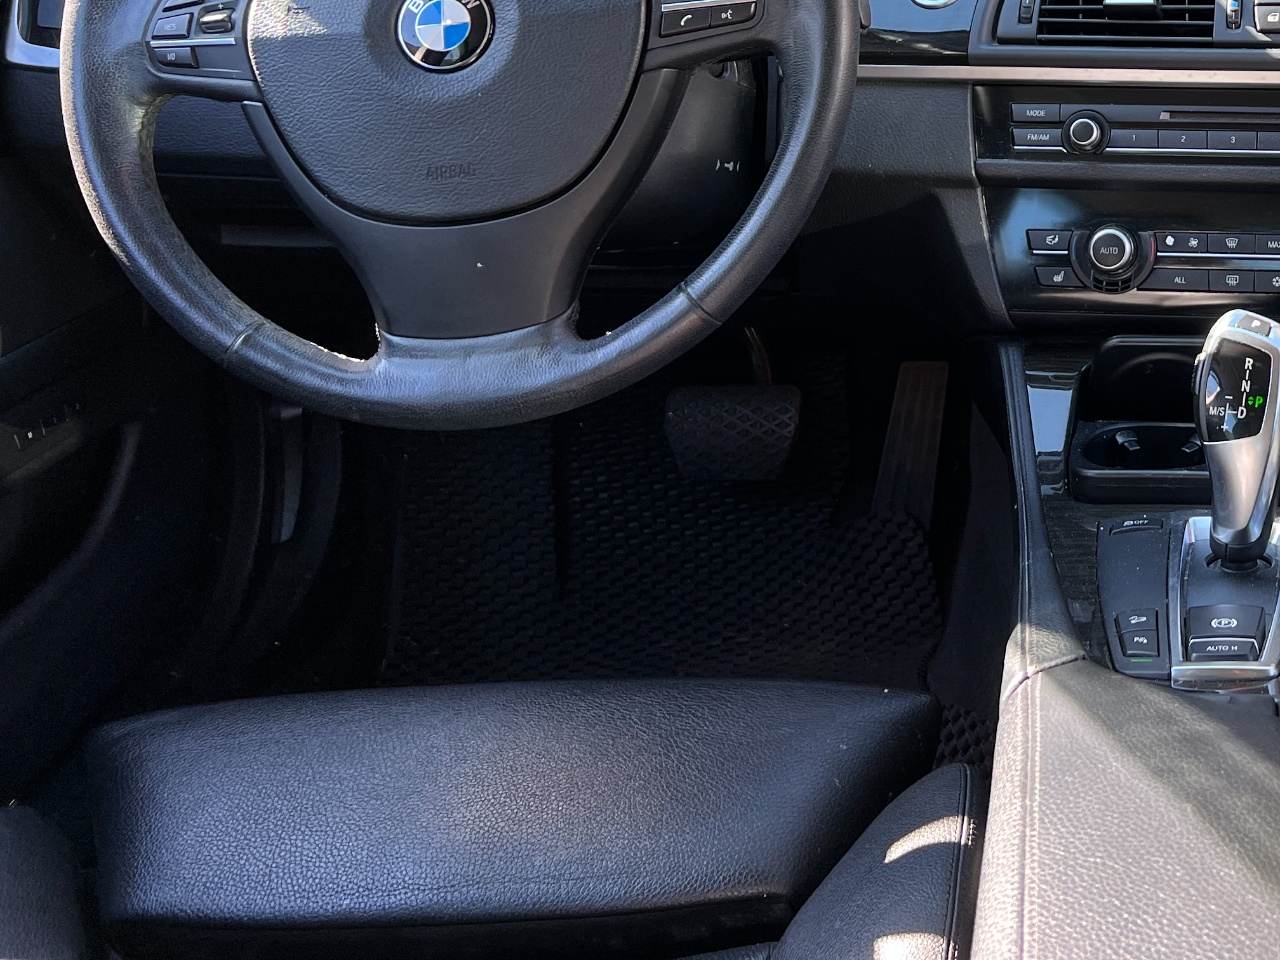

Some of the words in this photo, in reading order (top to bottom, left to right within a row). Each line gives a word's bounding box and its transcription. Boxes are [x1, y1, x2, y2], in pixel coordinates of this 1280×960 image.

[163, 22, 177, 31] RES
[1026, 109, 1046, 117] MODE
[1027, 133, 1050, 141] FM/AM
[1132, 134, 1136, 142] 1
[1180, 135, 1186, 143] 2
[1230, 136, 1236, 144] 3
[424, 163, 478, 181] AIRBAG
[1100, 246, 1119, 255] AUTO
[1174, 276, 1186, 284] ALL
[1251, 319, 1261, 328] P
[1244, 358, 1254, 370] R
[1241, 380, 1251, 392] N
[1255, 396, 1264, 408] P
[1209, 406, 1225, 416] M/S
[1237, 406, 1247, 419] D
